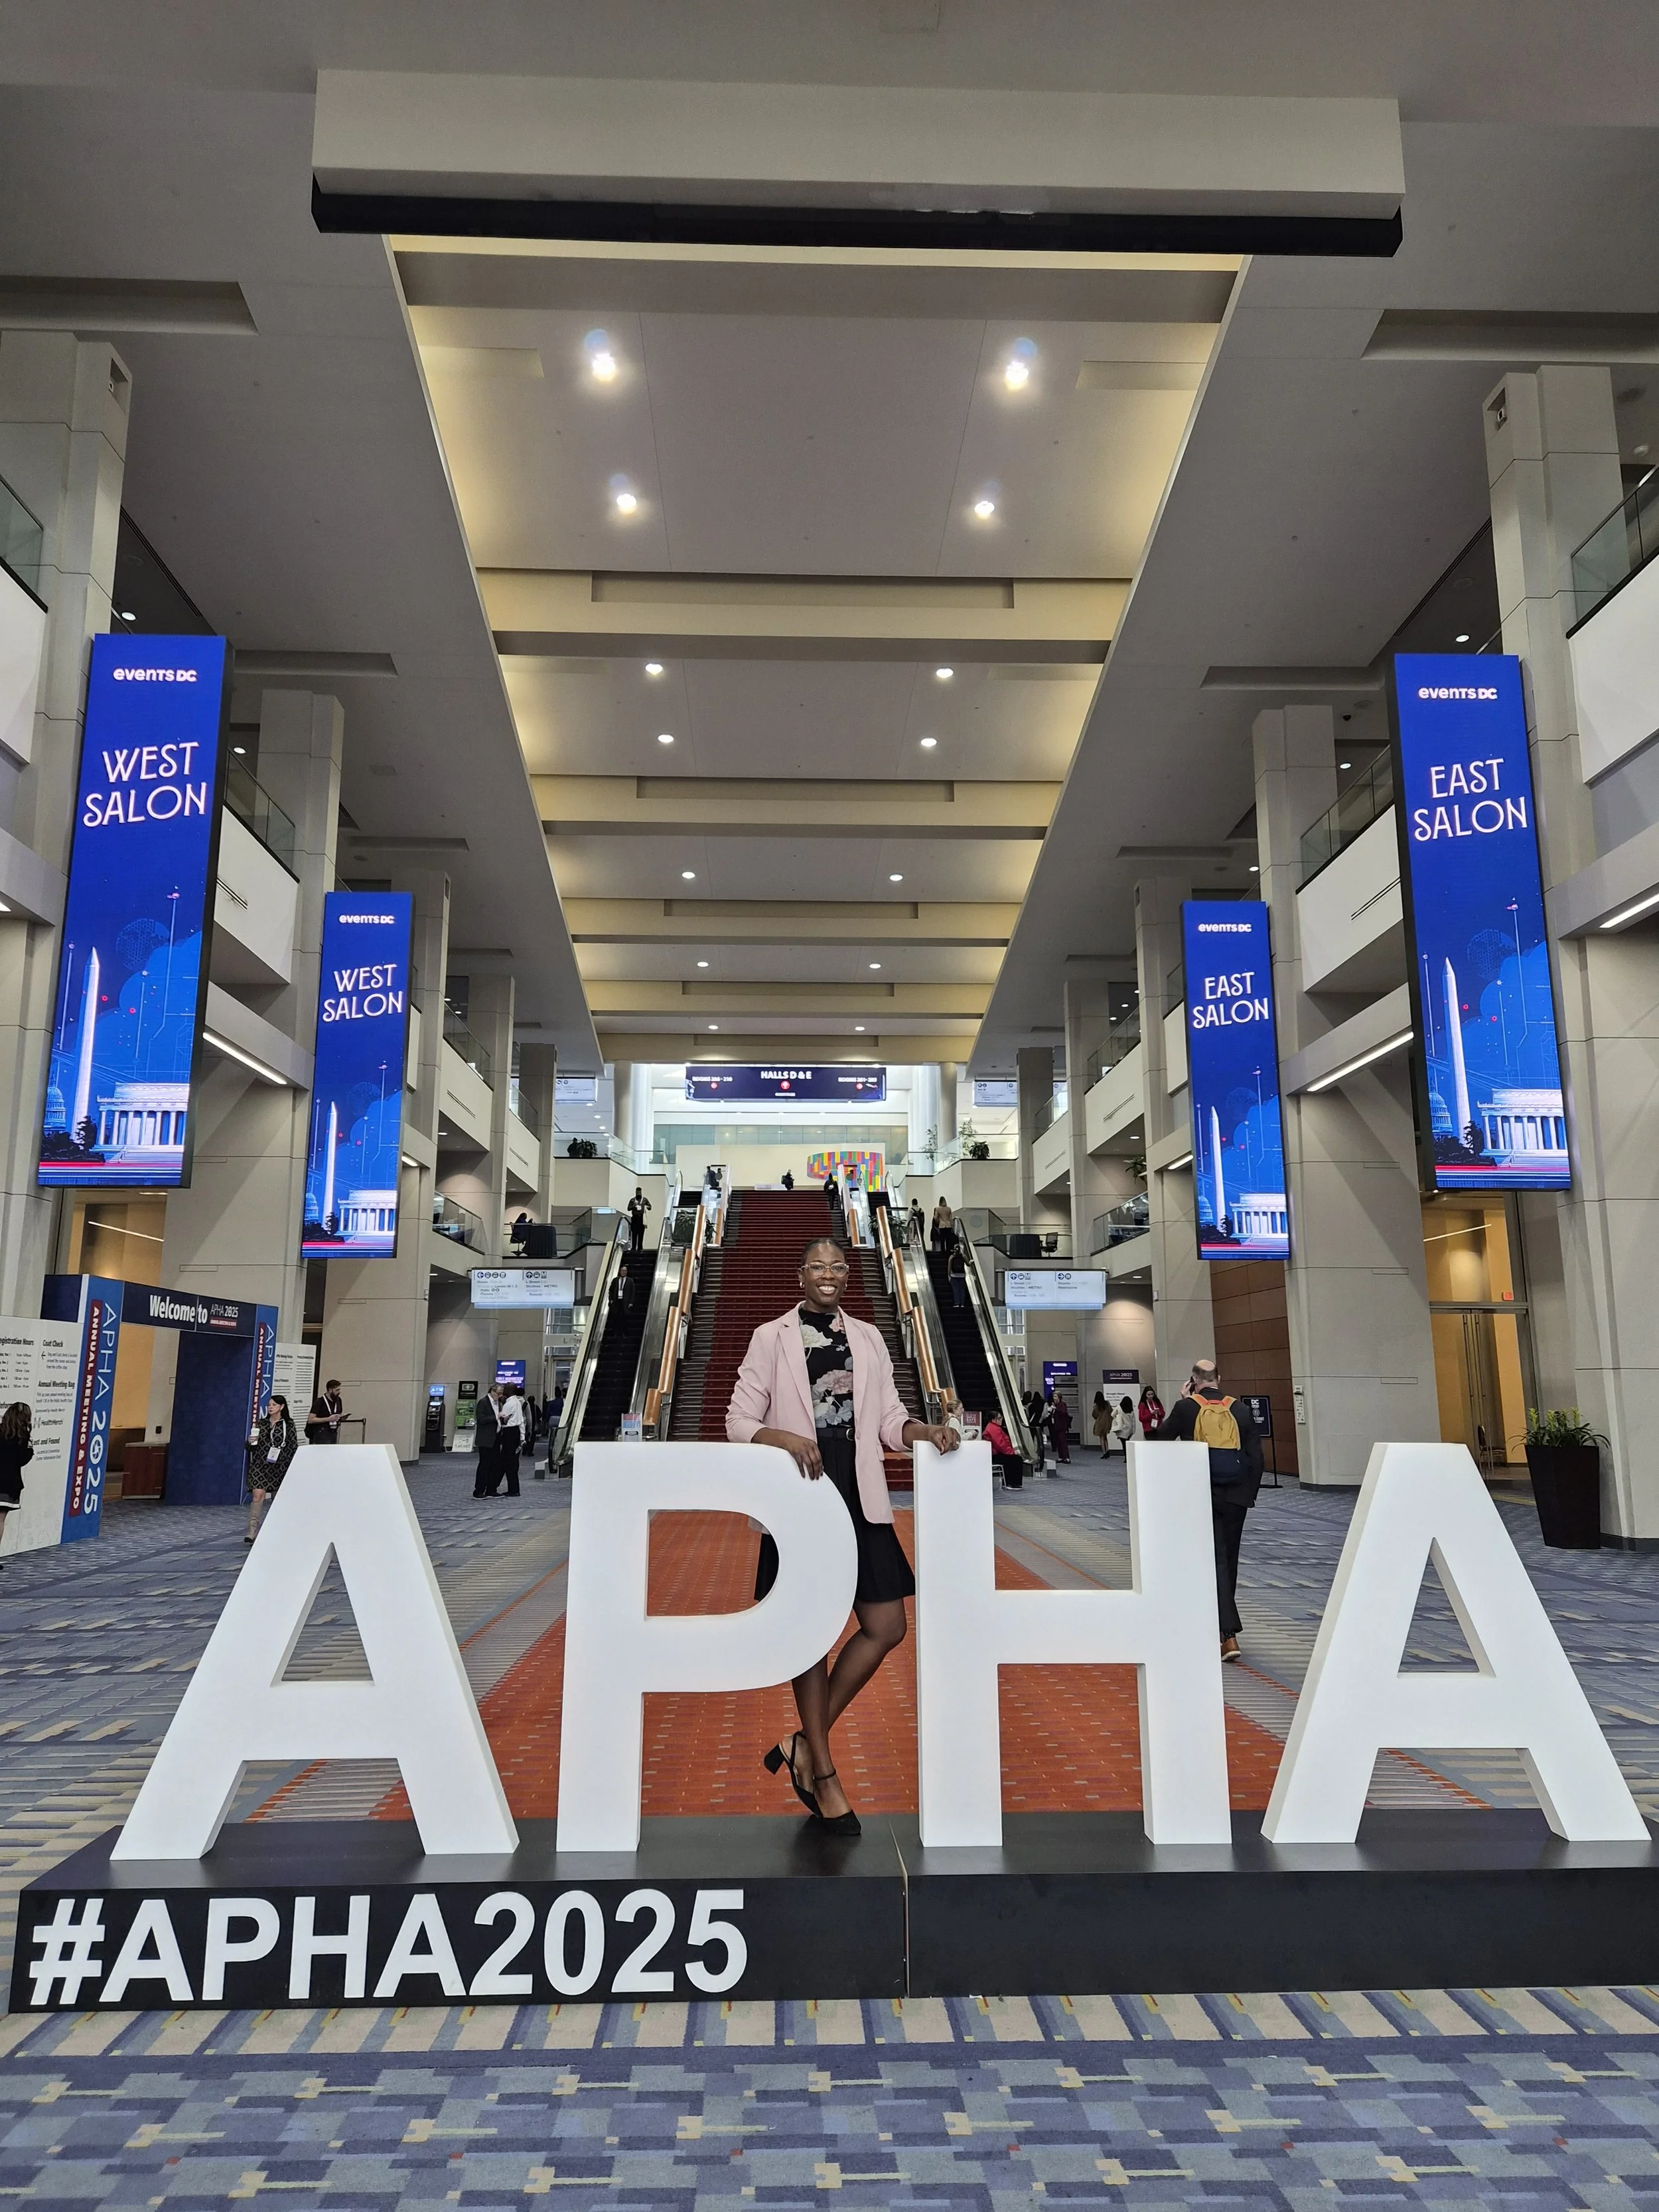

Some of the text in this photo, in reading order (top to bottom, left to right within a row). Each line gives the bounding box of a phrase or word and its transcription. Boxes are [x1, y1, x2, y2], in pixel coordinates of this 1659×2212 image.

[102, 741, 199, 783] WEST
[1430, 758, 1504, 798] EAST
[83, 782, 208, 828] SALON
[1413, 796, 1528, 842] SALON
[334, 964, 397, 992] WEST
[1204, 971, 1255, 999] EAST
[323, 991, 403, 1022] SALON
[1192, 997, 1269, 1029] SALON
[760, 1070, 788, 1079] HALLS
[798, 1070, 805, 1079] &
[149, 1294, 208, 1324] Welcome to
[210, 1303, 239, 1318] APHA 2025
[87, 1306, 100, 1371] ANNUAL
[260, 1324, 275, 1398] APHA
[80, 1374, 94, 1445] MEETING
[84, 1303, 117, 1514] APHA 2025
[73, 1466, 84, 1510] EXPO
[109, 1441, 1652, 1860] APHA
[29, 1888, 749, 2006] #APHA2025
